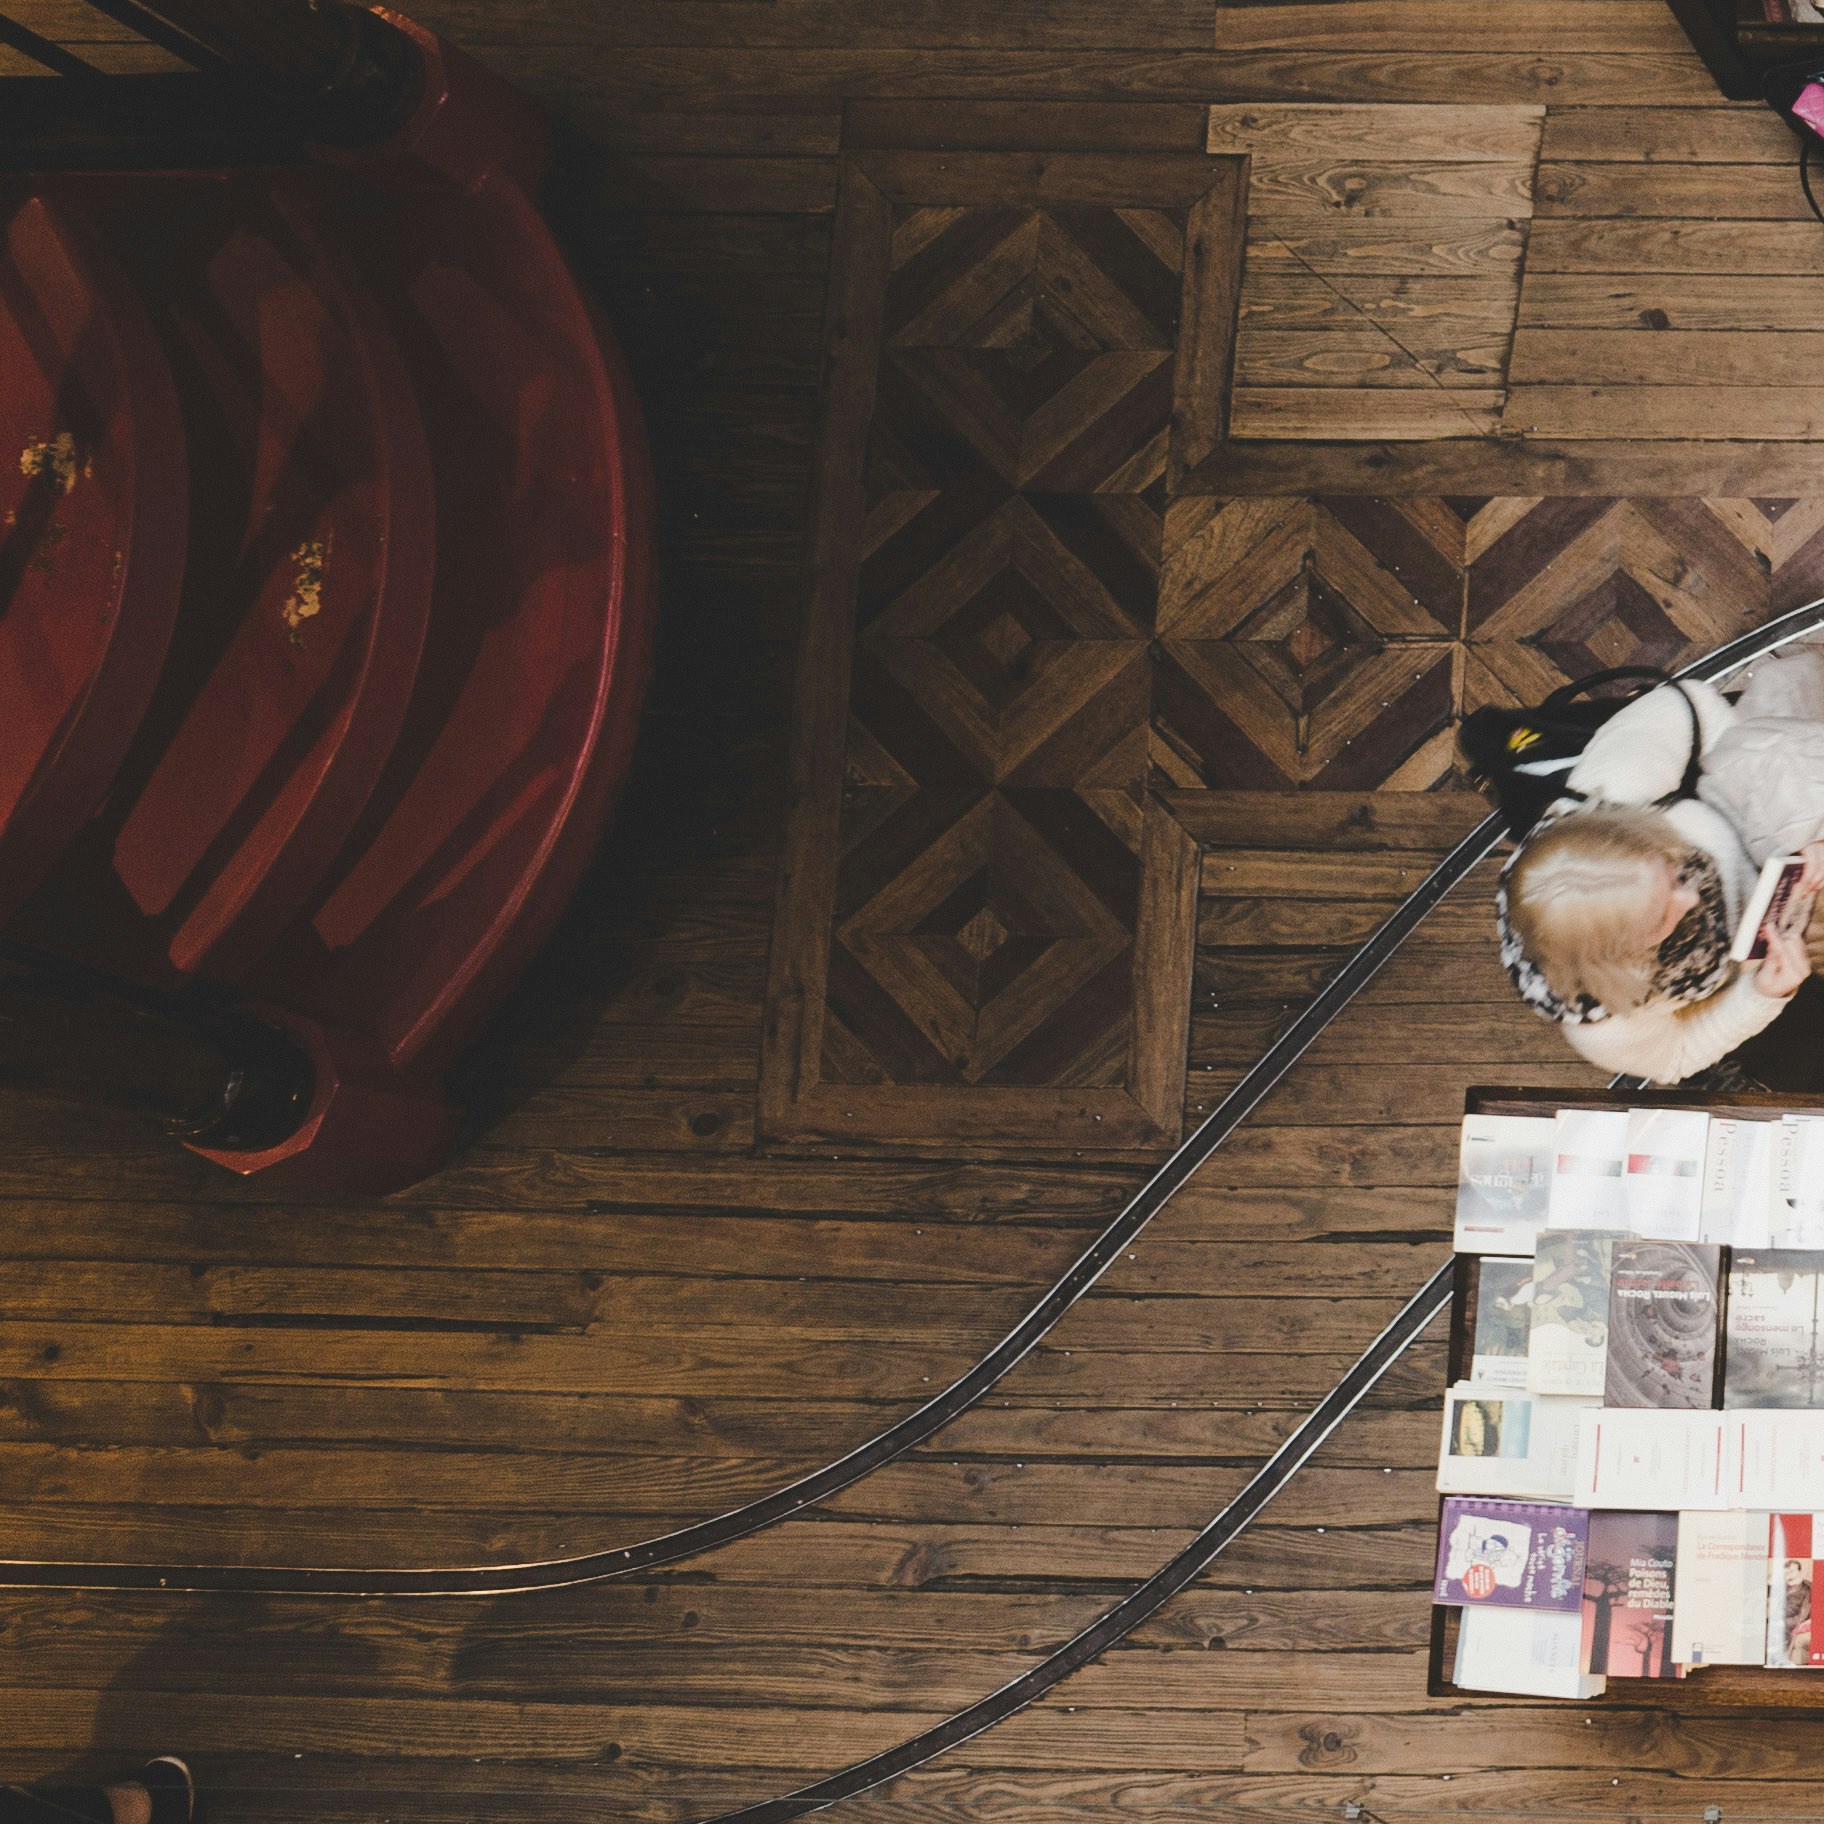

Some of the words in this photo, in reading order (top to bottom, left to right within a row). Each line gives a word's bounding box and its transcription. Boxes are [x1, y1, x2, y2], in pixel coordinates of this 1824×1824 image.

[1713, 1122, 1737, 1192] Pessoa
[1779, 1122, 1799, 1192] Pessoa
[1645, 1559, 1673, 1568] Couto
[1628, 1568, 1665, 1578] Poisons
[1628, 1578, 1640, 1587] de
[1628, 1599, 1639, 1608] du
[1641, 1599, 1674, 1609] Diable
